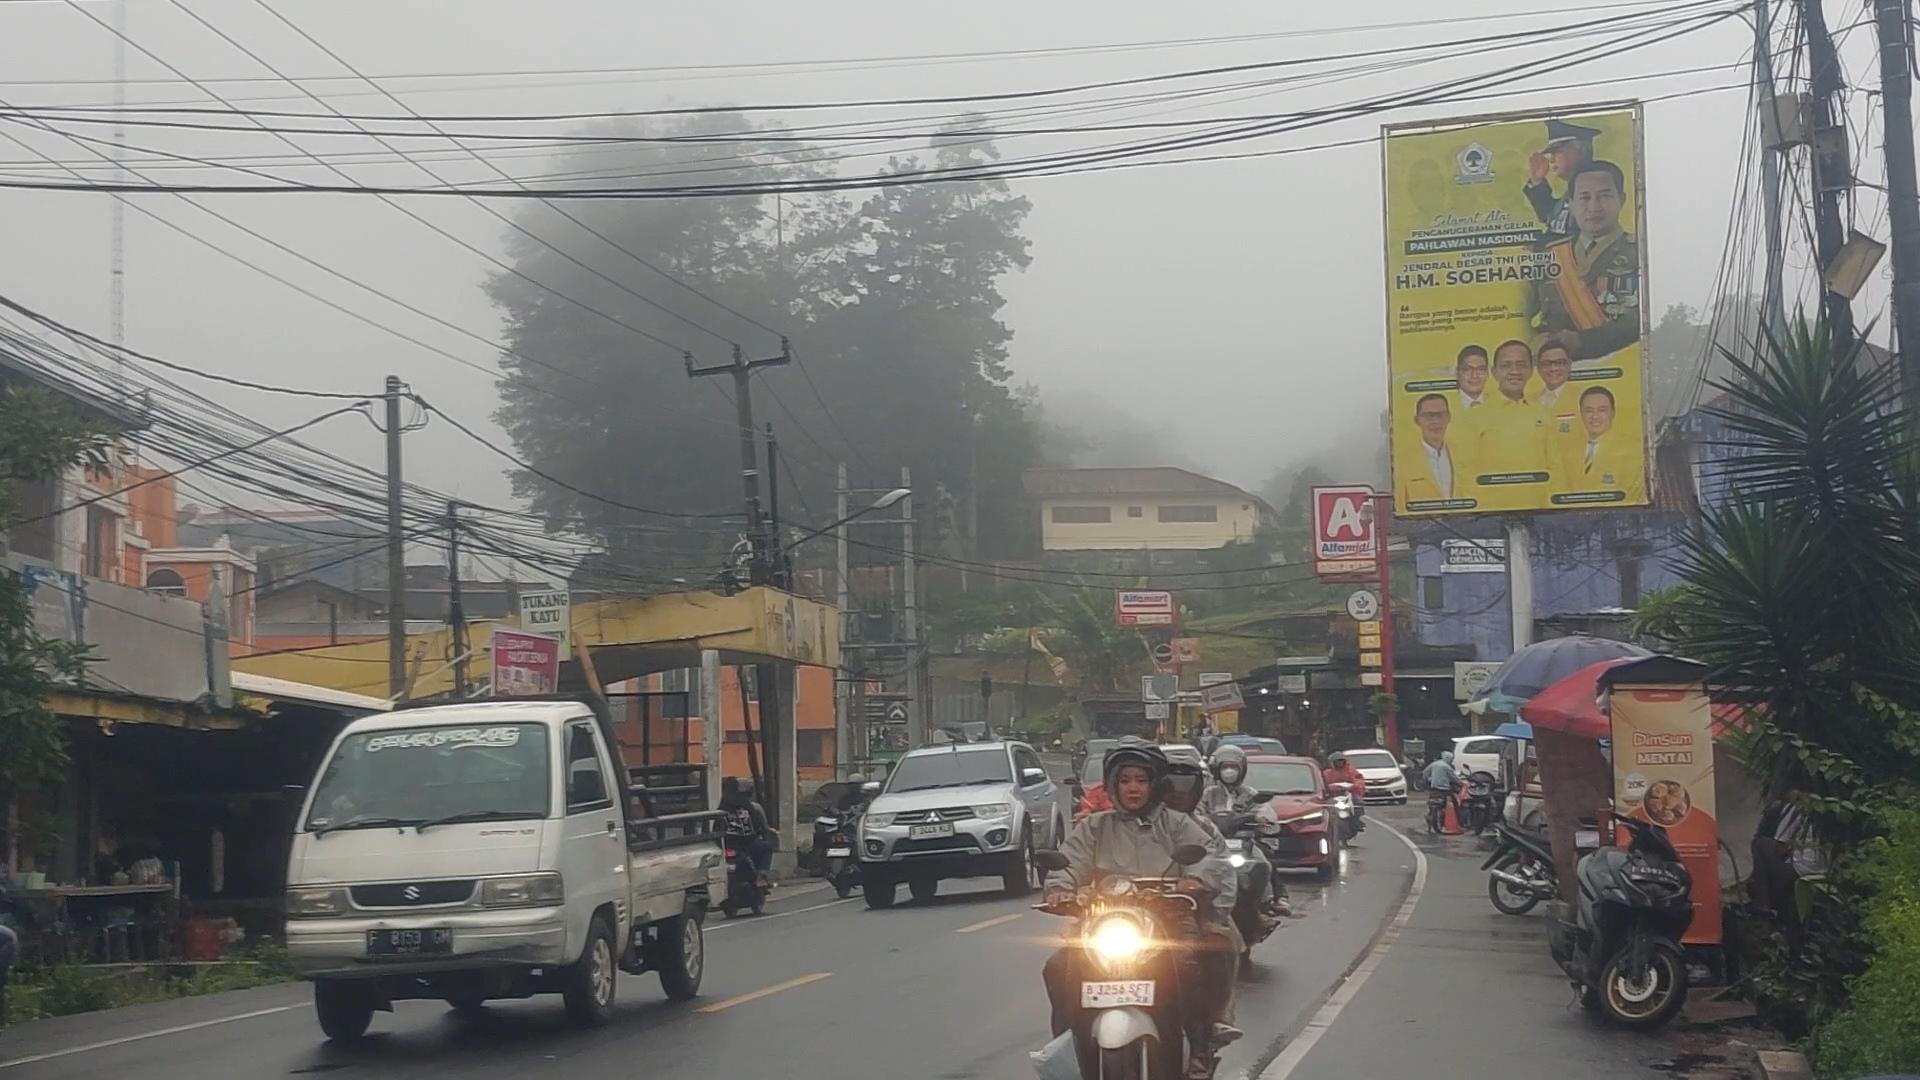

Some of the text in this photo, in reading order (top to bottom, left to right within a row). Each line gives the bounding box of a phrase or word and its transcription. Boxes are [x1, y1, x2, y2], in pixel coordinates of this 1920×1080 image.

[1434, 212, 1479, 228] Selamat
[1503, 221, 1534, 230] GELAR
[1410, 233, 1536, 251] PAHLAWAN NASIONAL
[1403, 261, 1452, 273] JENDRAL
[1456, 257, 1492, 268] BESAR
[1496, 255, 1514, 265] TNI
[1396, 263, 1562, 290] H.M. SOEHARTO
[1322, 541, 1370, 553] Alfamidi
[522, 593, 568, 608] TUKANG
[1123, 593, 1168, 603] Alfamart
[1636, 752, 1692, 765] MENTAI
[1086, 984, 1093, 995] B
